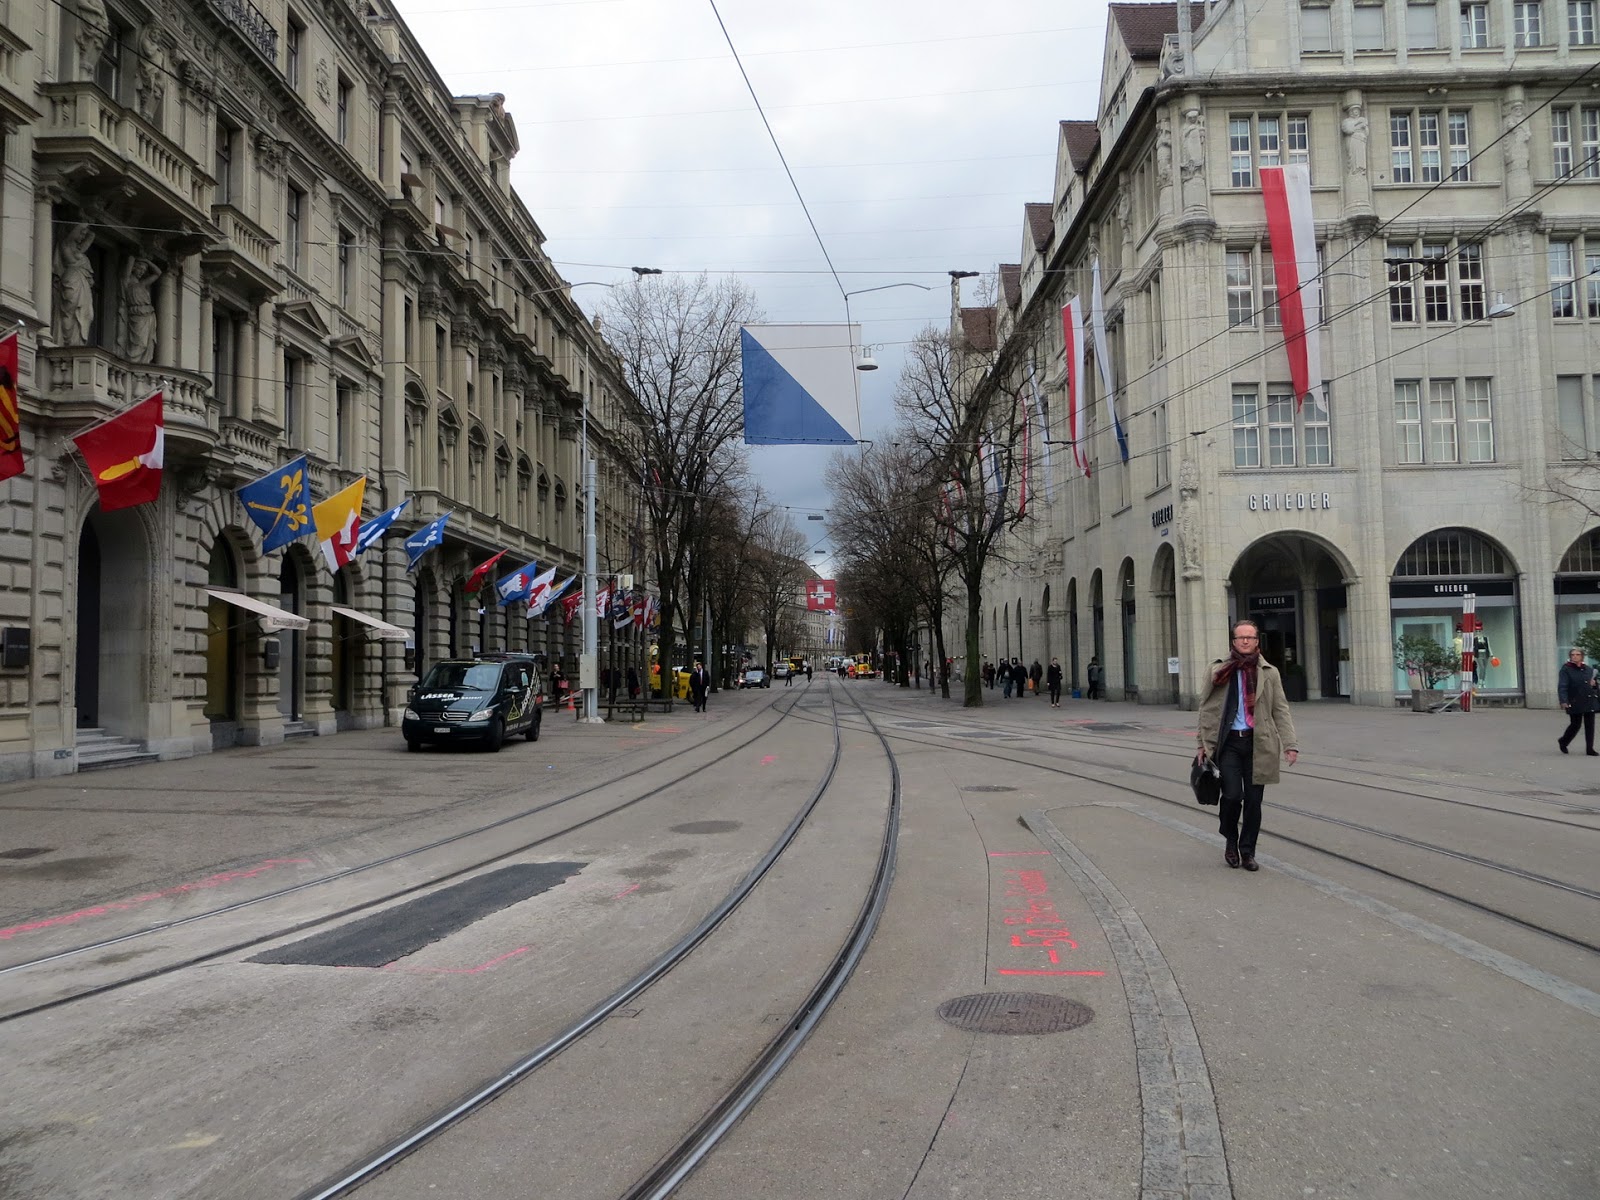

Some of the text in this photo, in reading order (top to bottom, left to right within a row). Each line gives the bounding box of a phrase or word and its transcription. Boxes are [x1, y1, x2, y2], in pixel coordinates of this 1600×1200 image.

[1249, 492, 1330, 511] GRIEDER
[1434, 584, 1468, 593] GRIEDER
[1258, 597, 1285, 605] GRIEDER
